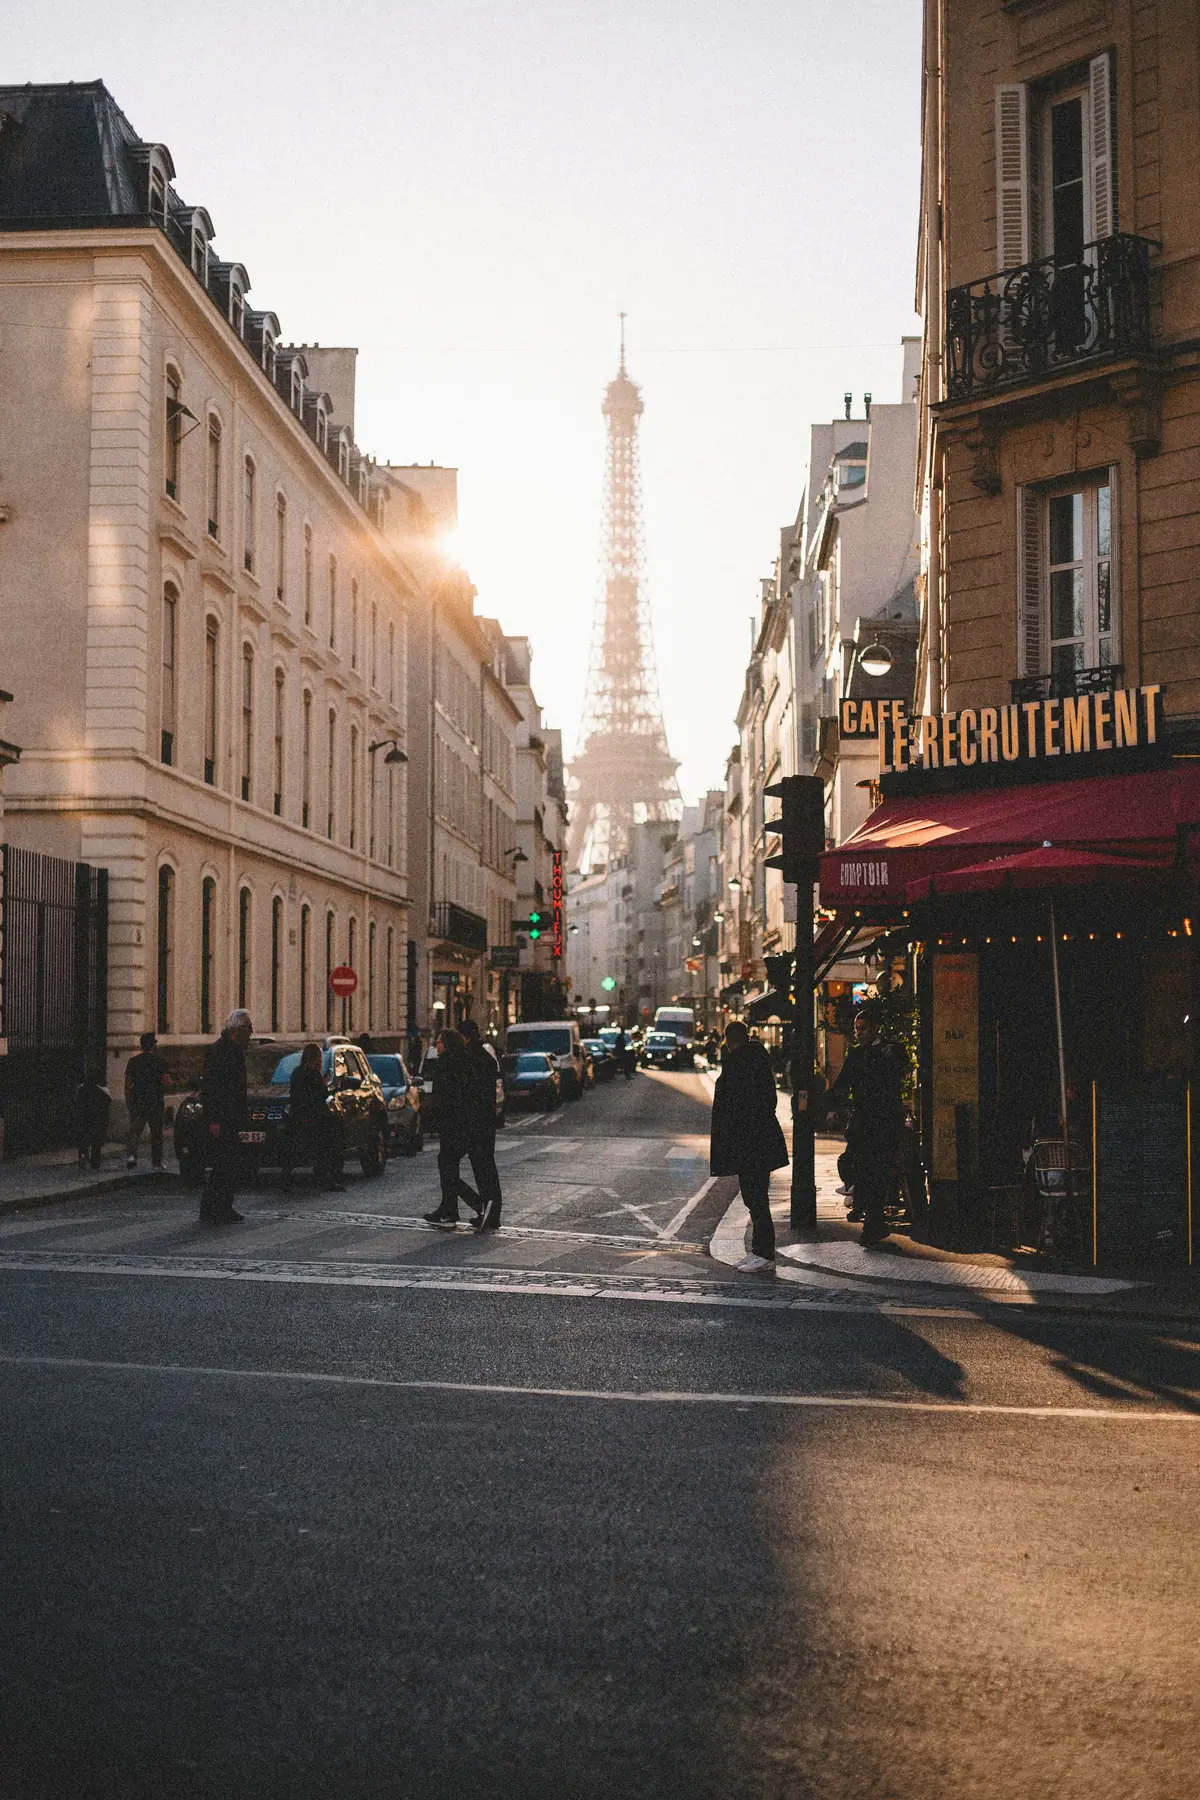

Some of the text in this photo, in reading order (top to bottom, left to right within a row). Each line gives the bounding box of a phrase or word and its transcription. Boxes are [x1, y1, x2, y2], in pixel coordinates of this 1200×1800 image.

[880, 685, 1160, 773] LE RECRUTEMENT
[840, 862, 889, 886] COMPTOIR
